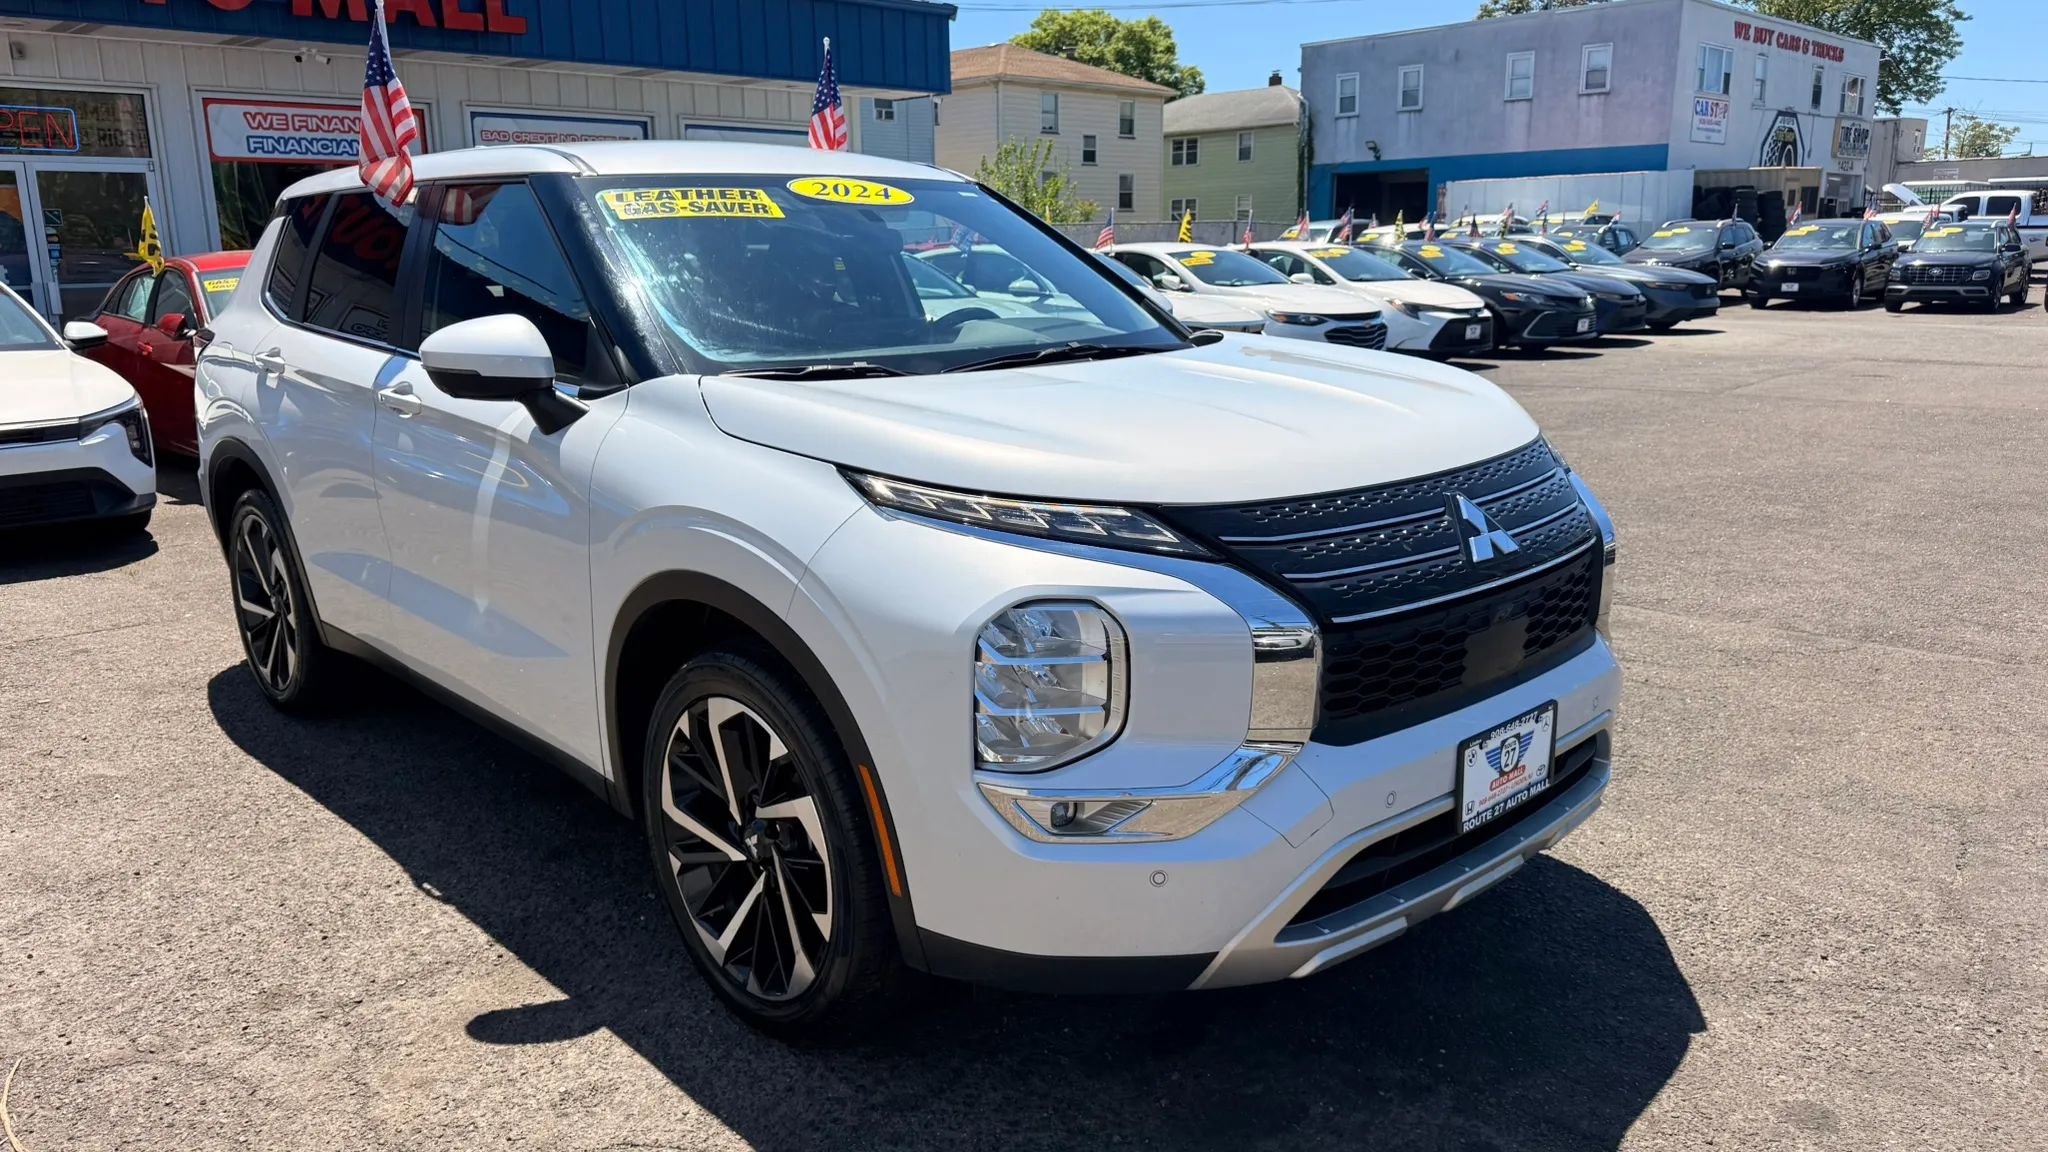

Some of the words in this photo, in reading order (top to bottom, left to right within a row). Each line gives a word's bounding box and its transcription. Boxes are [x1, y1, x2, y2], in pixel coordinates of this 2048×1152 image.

[1734, 21, 1751, 41] WE
[1752, 26, 1775, 46] BUY
[1776, 32, 1801, 52] CARS
[1802, 39, 1810, 55] &
[1811, 41, 1844, 62] TRUCKS
[1695, 100, 1709, 117] CAR
[0, 109, 75, 149] PEN
[244, 112, 288, 131] WE
[292, 115, 360, 134] FINAN
[246, 135, 359, 155] FINANCIA
[481, 130, 510, 143] BAD
[512, 132, 558, 143] CREDIT
[1841, 126, 1852, 142] TIRE
[1853, 128, 1869, 145] SHOP
[615, 189, 759, 203] LEATHER
[812, 182, 891, 200] 2024
[624, 201, 770, 216] GAS-SAVER
[1504, 747, 1516, 768] 27
[1491, 774, 1508, 789] AUTO
[1463, 811, 1493, 832] ROUTE
[1494, 803, 1504, 816] 27
[1505, 791, 1528, 809] AUTO
[1530, 778, 1550, 798] MALL
